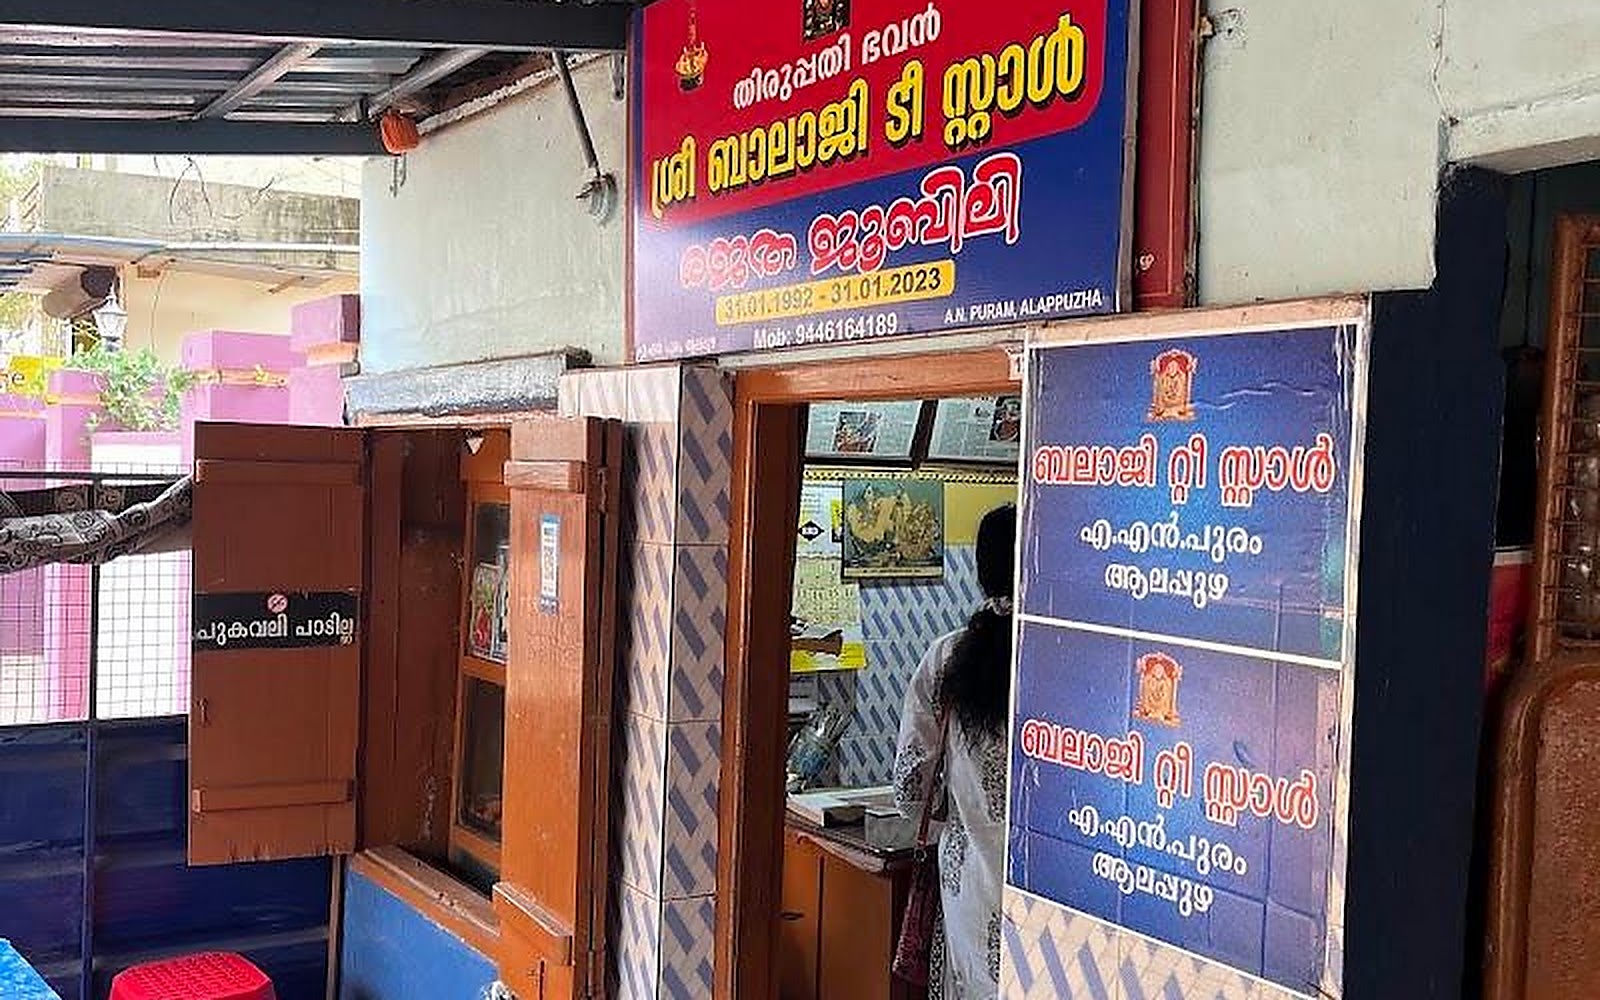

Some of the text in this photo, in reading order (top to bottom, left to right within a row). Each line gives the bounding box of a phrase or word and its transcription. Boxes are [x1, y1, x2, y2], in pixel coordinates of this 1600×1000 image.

[733, 2, 942, 110] തിരുപ്പതി ഭവൻ
[651, 13, 1085, 219] ശ്രീ ബാലാജി ടീ സ്റ്റാൾ
[808, 153, 1021, 275] ജൂബിലി
[724, 287, 814, 319] 31.01.1992
[831, 268, 941, 304] 31.01.2023
[970, 301, 1017, 320] PURAM,
[1019, 289, 1103, 317] ALAPPUZHA
[754, 313, 898, 349] Mob: 9446164189
[1032, 433, 1335, 507] ബലാജി റ്റീ സ്റ്റാൾ
[1105, 562, 1229, 608] ആലപ്പുഴ
[197, 611, 354, 646] പുകവലി പാടില്ല
[1021, 718, 1319, 830] ബലാജി റ്റീ സ്റ്റാൾ
[1093, 851, 1214, 917] ആലപ്പുഴ
